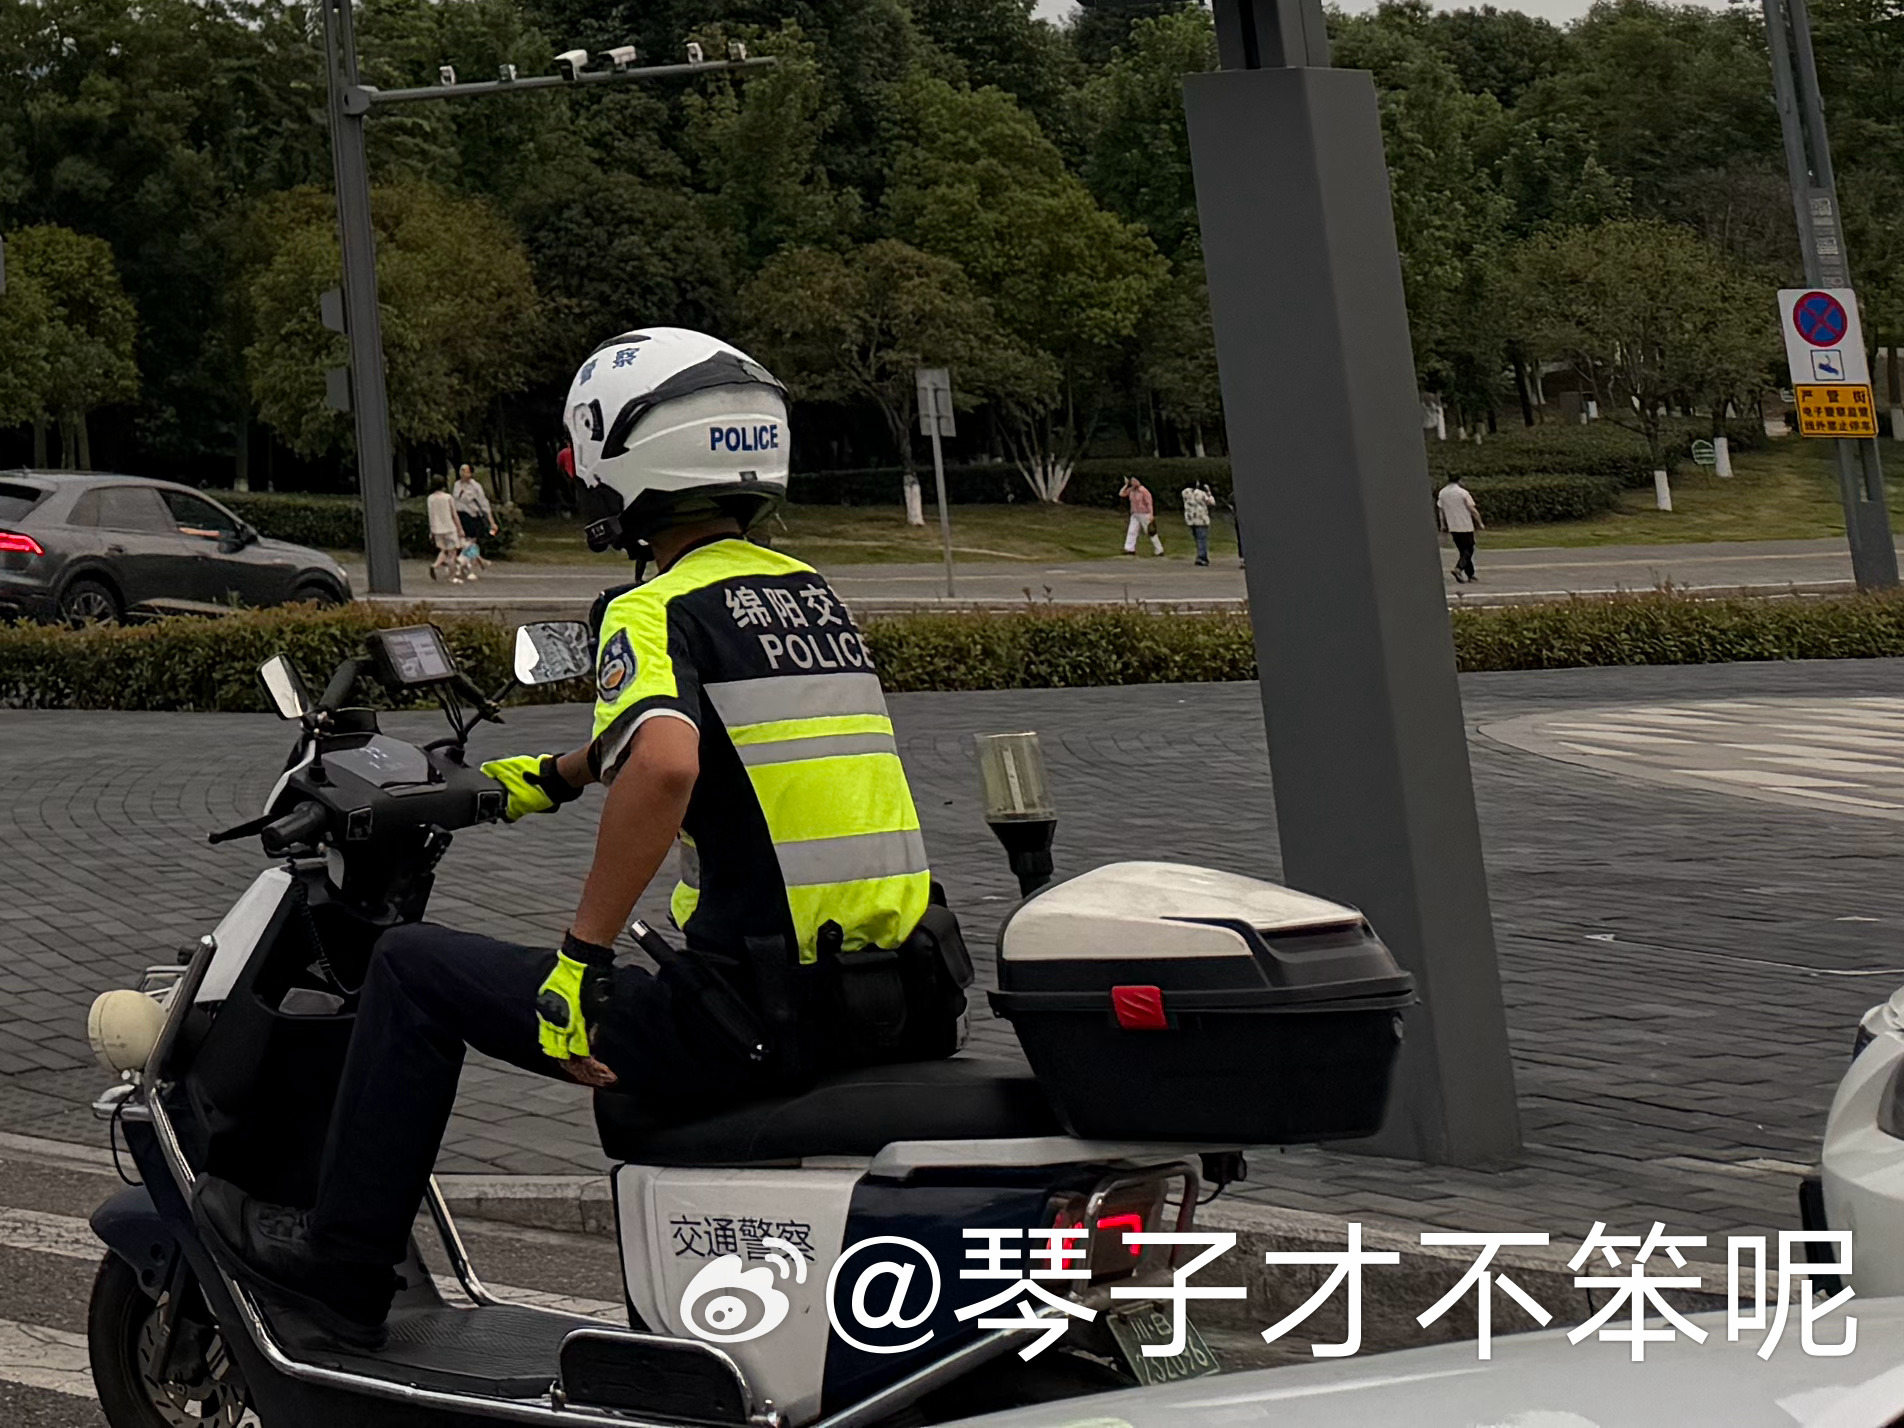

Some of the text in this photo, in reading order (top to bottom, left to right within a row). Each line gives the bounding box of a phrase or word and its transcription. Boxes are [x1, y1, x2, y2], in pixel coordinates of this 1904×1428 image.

[710, 424, 779, 451] POLICE
[758, 632, 875, 669] POLICE
[670, 1214, 816, 1263] 交通警察
